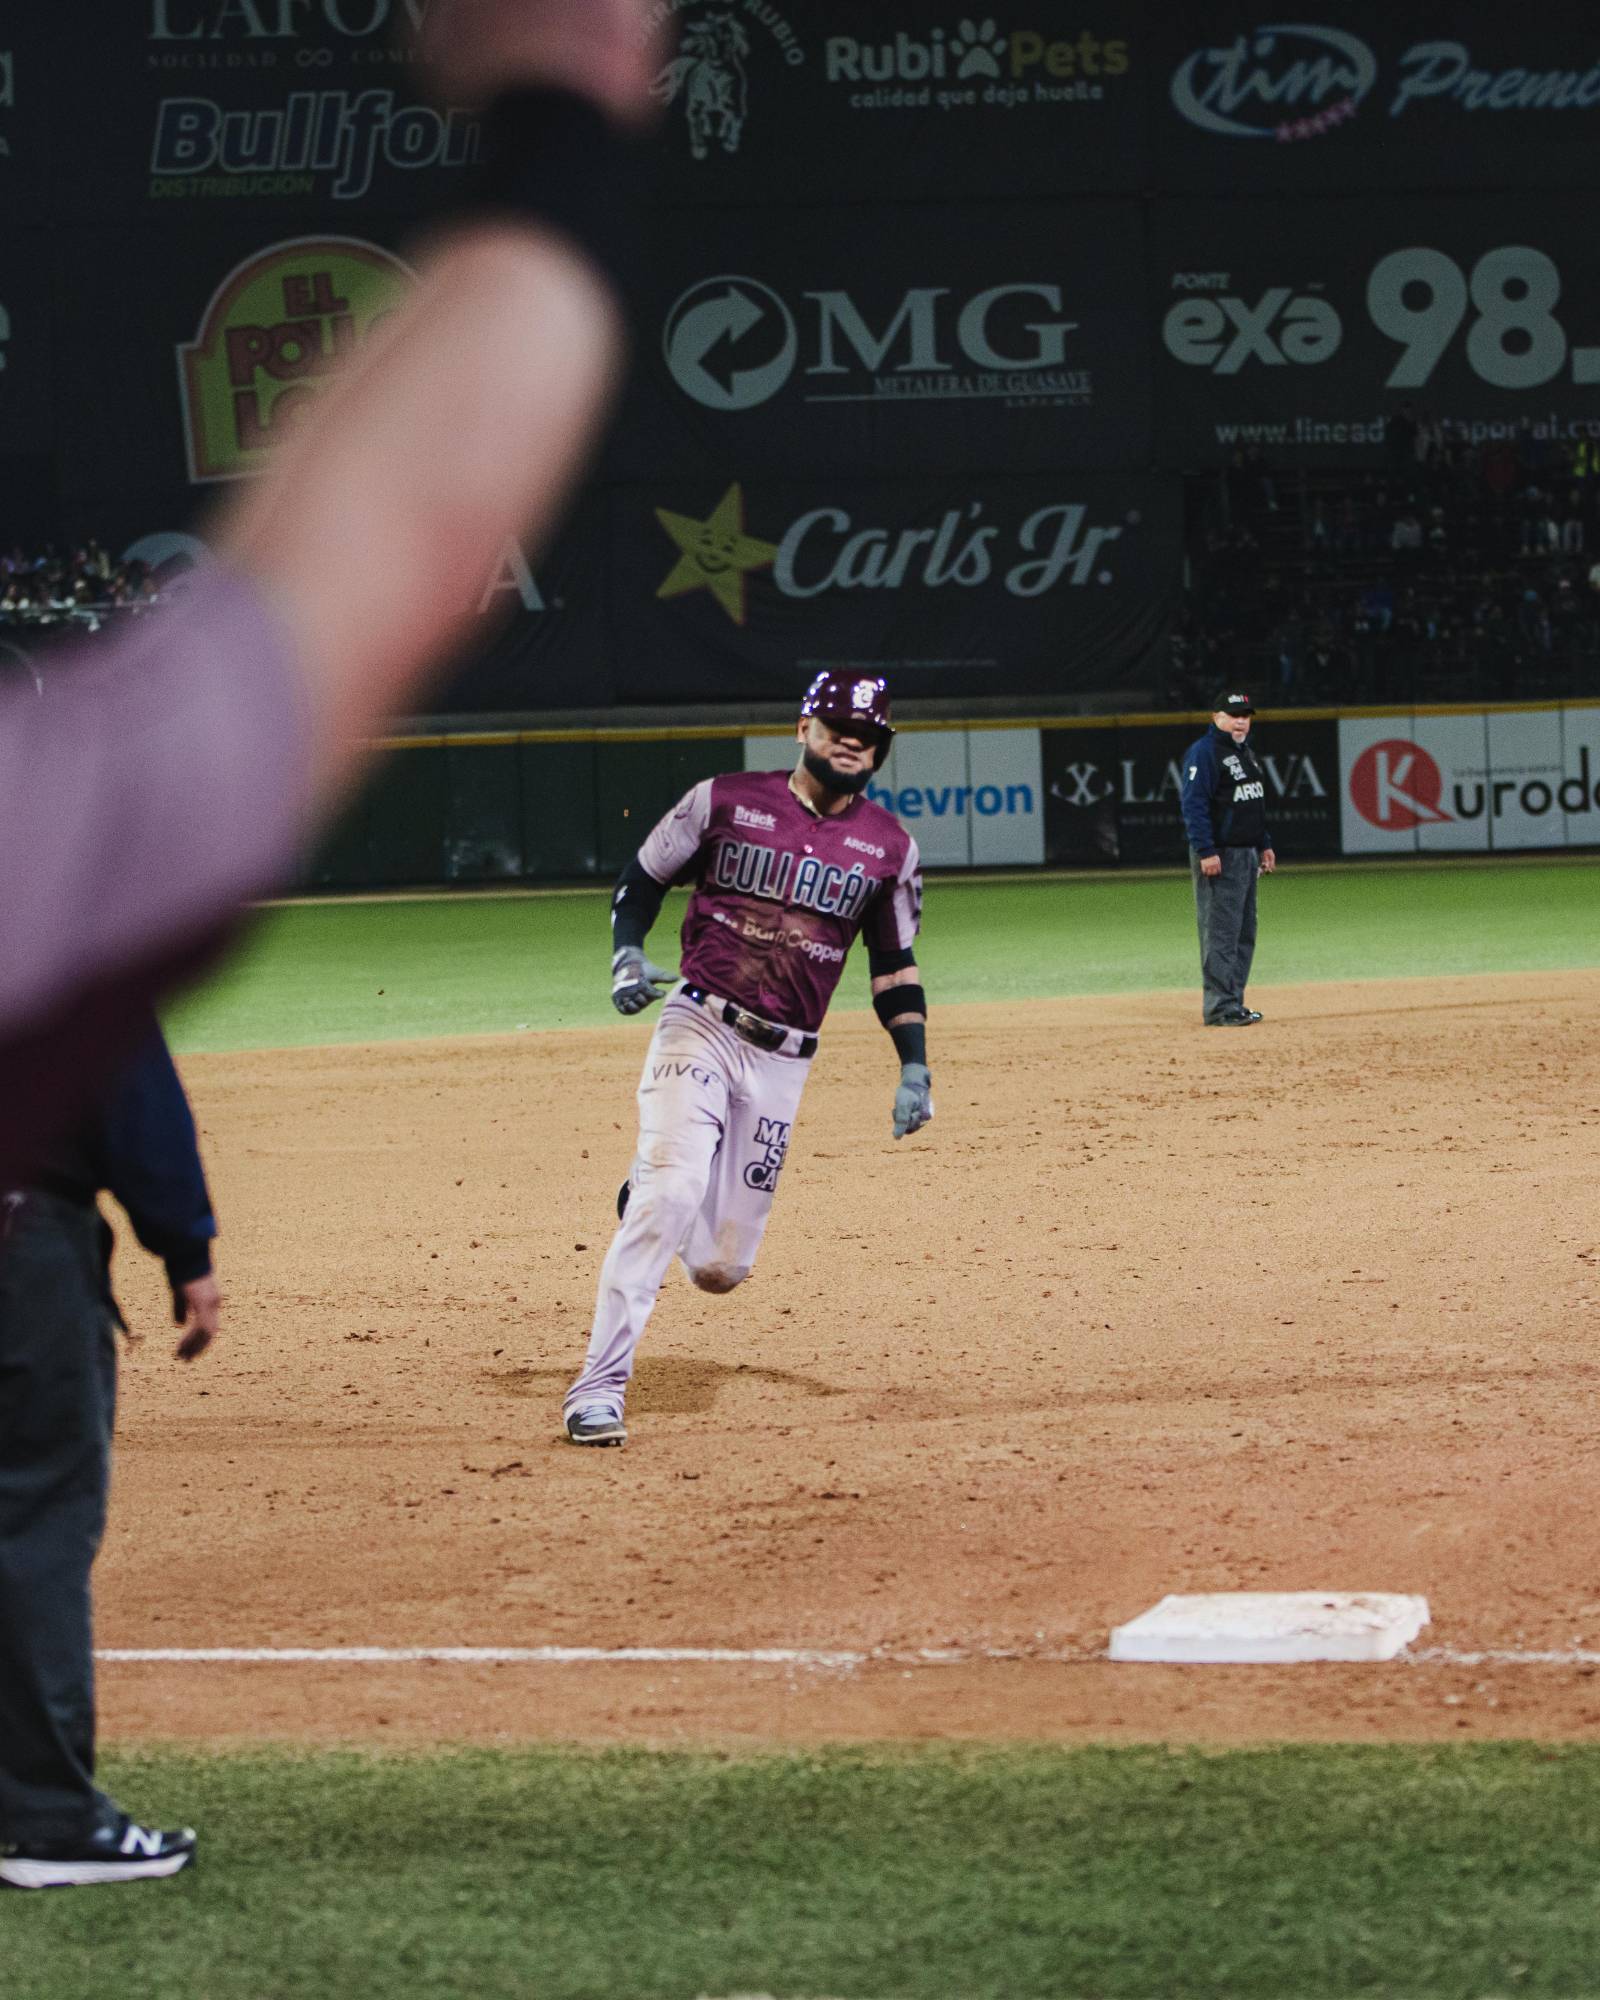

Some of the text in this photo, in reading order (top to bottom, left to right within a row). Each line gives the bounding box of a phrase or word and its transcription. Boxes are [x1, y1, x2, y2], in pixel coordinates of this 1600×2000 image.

[825, 27, 1129, 81] Rubi Pets
[850, 80, 1104, 110] calidad que deja huella
[283, 272, 348, 317] EL
[803, 283, 1079, 375] MG
[773, 502, 1125, 598] Carl's Jr.
[867, 782, 1033, 818] hevron
[1233, 782, 1264, 802] ARCO
